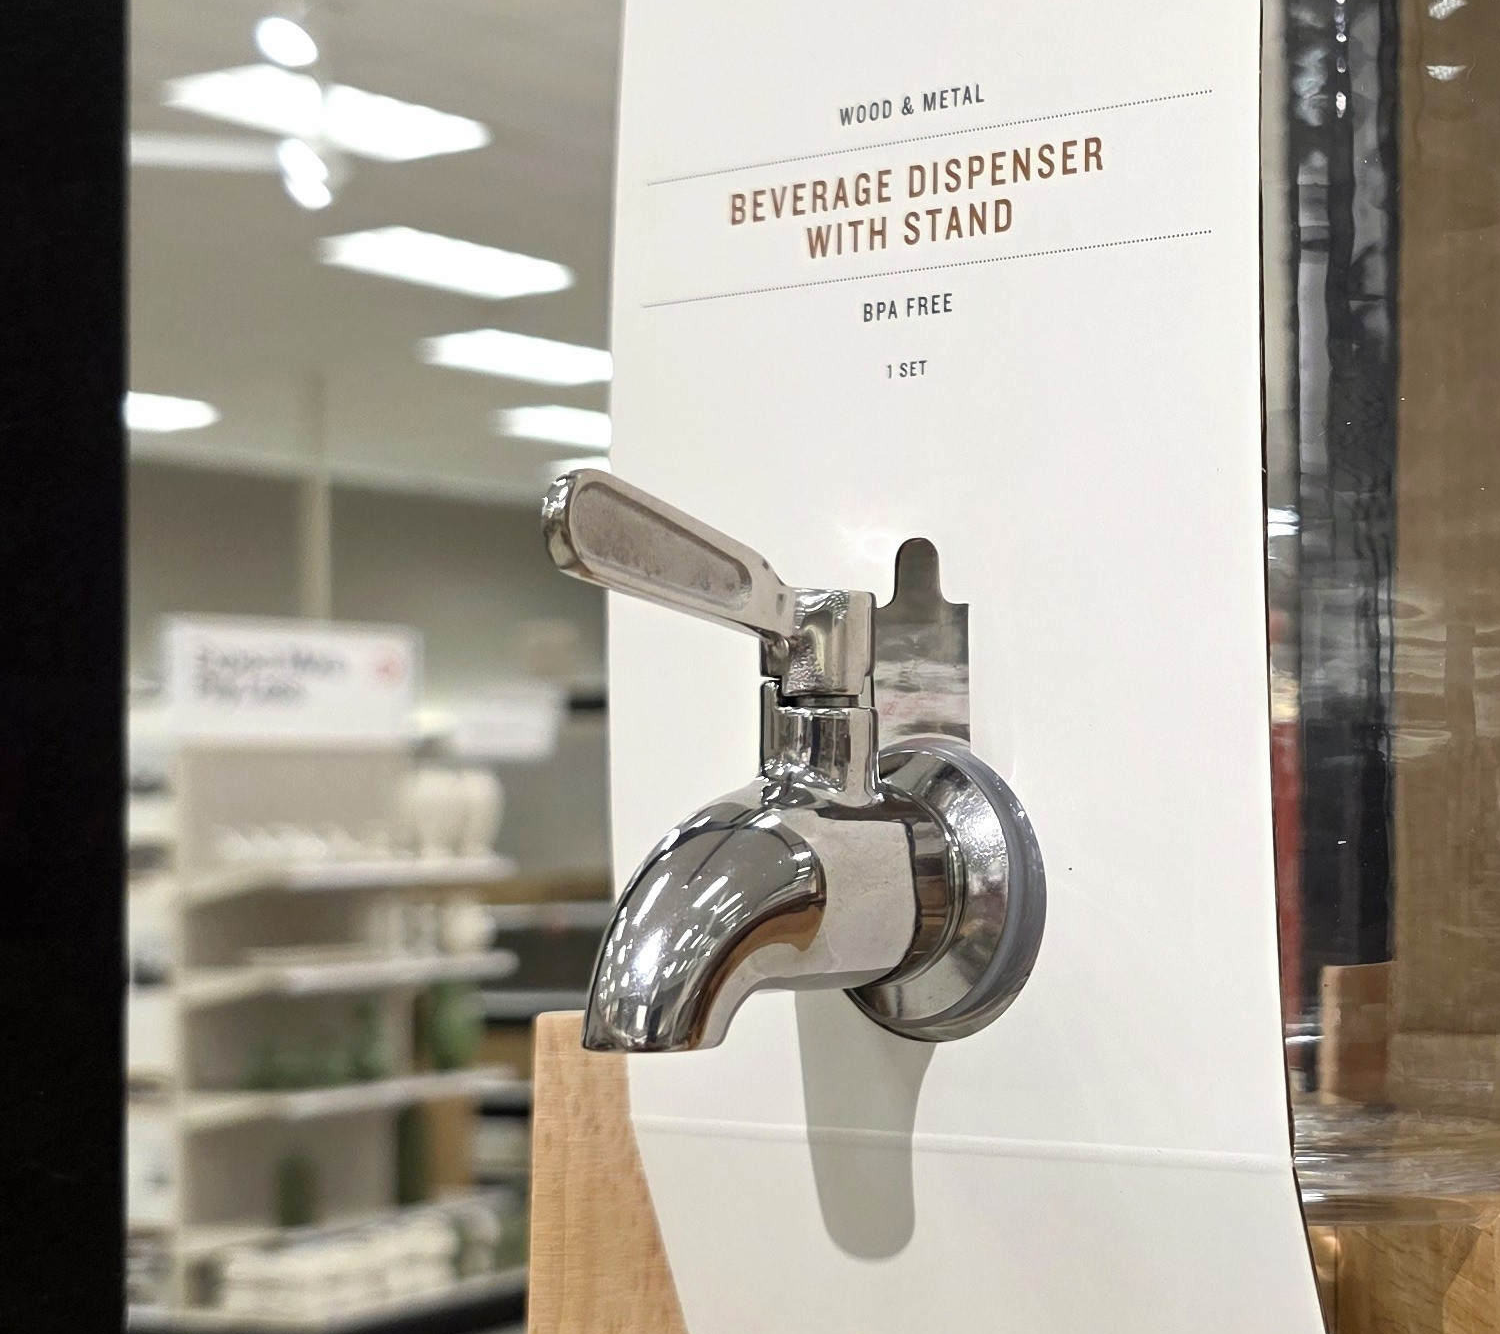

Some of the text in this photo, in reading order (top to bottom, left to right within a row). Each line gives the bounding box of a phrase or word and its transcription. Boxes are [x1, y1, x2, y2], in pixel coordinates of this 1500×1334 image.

[838, 83, 985, 127] WOOD & METAL
[730, 136, 1104, 226] BEVERAGE DISPENSER
[806, 198, 1013, 260] WITH STAND
[862, 293, 954, 323] BPA FREE
[886, 360, 928, 380] 1 SET
